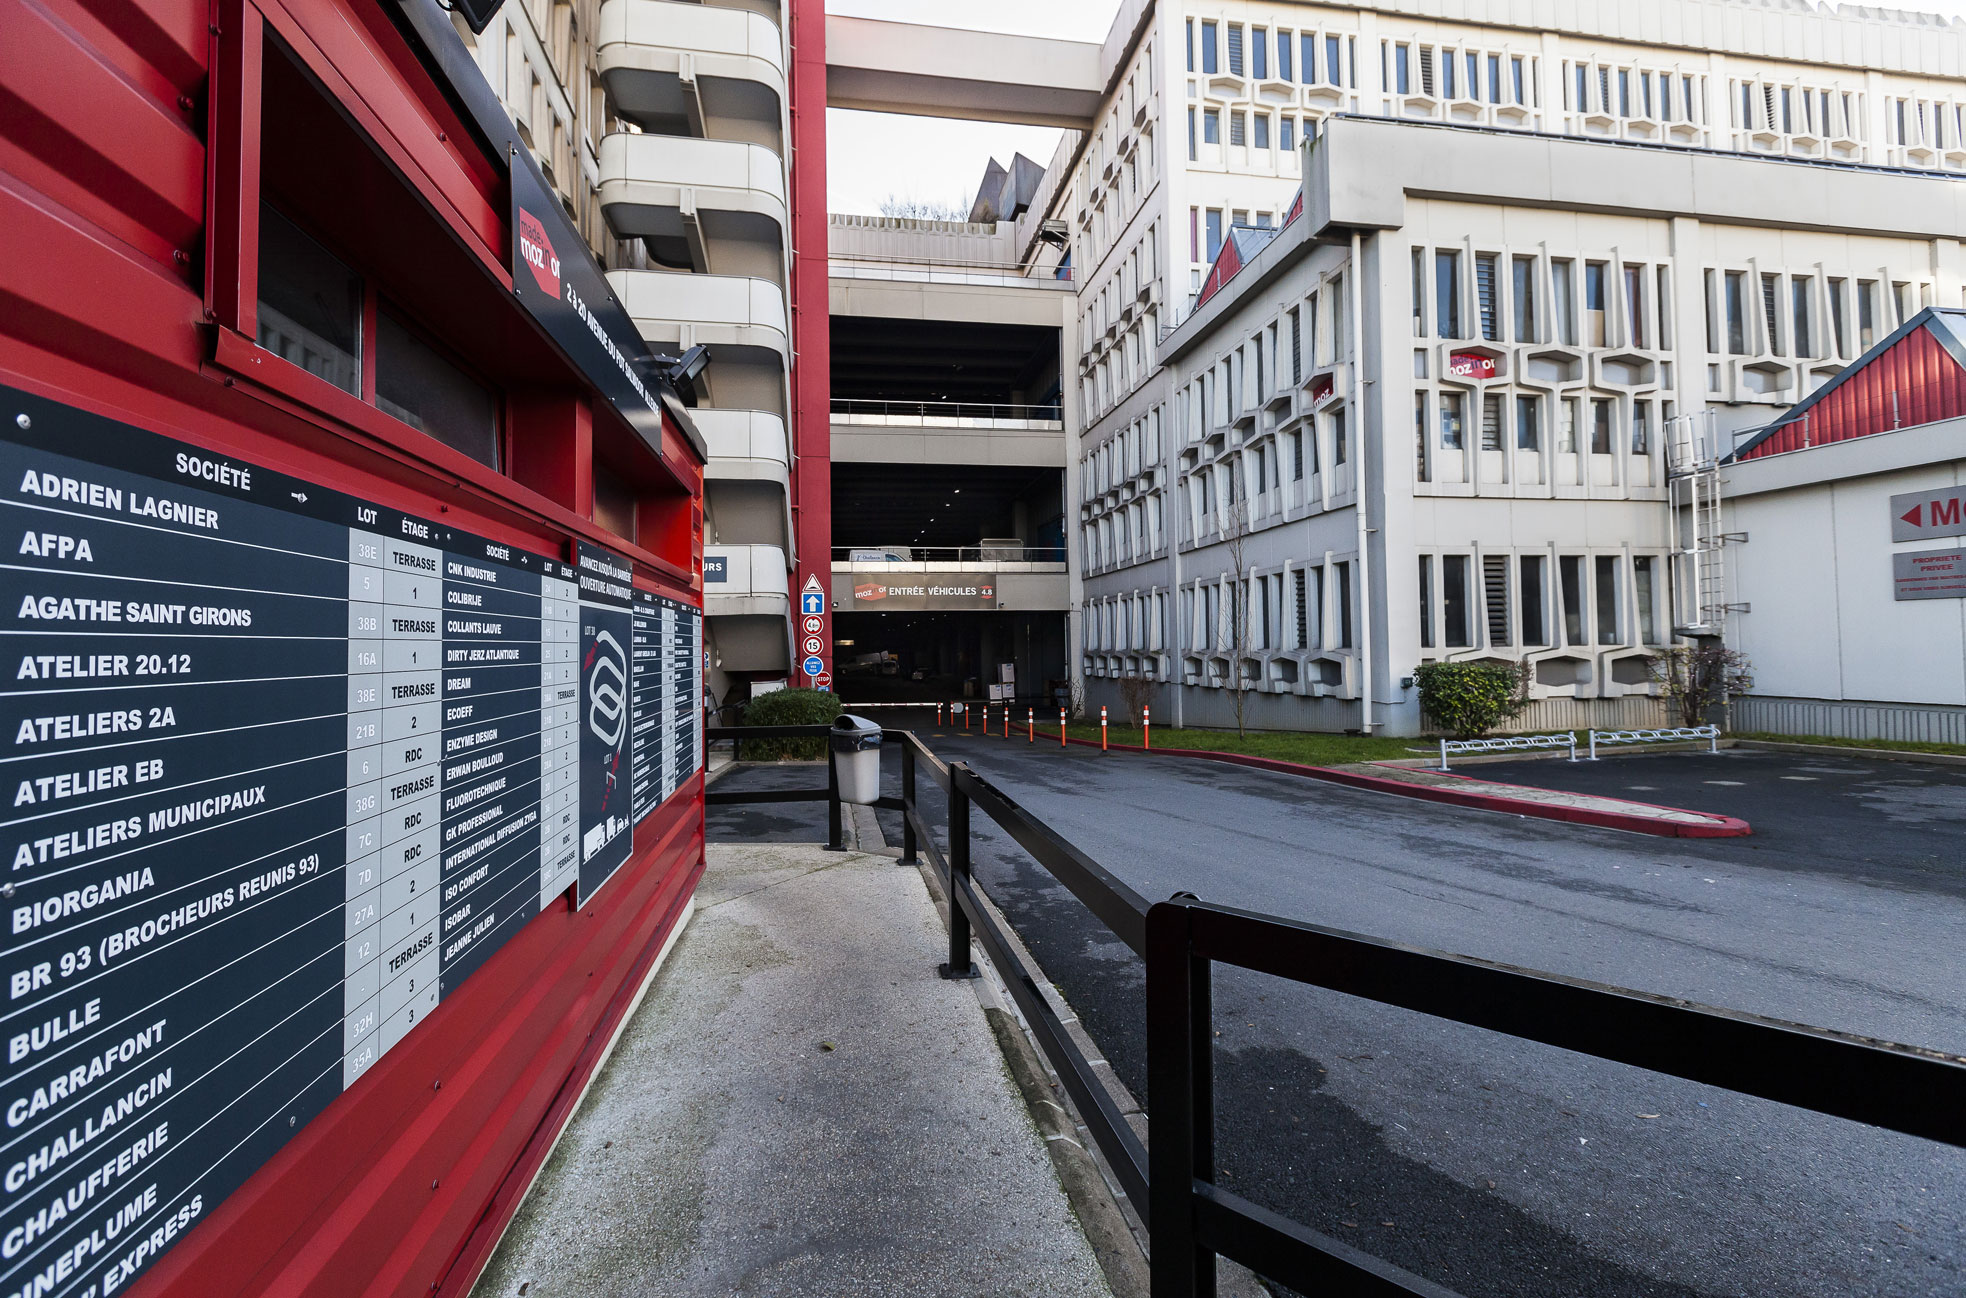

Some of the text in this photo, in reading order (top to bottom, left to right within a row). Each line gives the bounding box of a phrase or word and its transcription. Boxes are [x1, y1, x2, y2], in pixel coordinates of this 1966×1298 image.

[566, 282, 572, 304] 2
[578, 298, 586, 322] 20
[587, 310, 608, 350] AVENUE
[608, 338, 616, 360] DU
[616, 348, 625, 372] PDT
[625, 362, 644, 398] SALVADOR
[176, 452, 250, 490] SOCIÉTÉ
[20, 470, 219, 529] ADRIEN LAGNIER
[358, 506, 377, 525] LOT
[1930, 498, 1966, 526] M
[402, 517, 428, 540] ÉTAGE
[19, 530, 93, 562] AFPA
[358, 544, 377, 560] 38E
[486, 544, 509, 561] SOCIÉTÉ
[393, 552, 436, 571] TERRASSE
[580, 555, 598, 572] AVANCEZ
[613, 566, 617, 578] LA
[1912, 555, 1962, 564] PROPRIETE
[448, 562, 496, 582] CNK INDUSTRIE
[561, 565, 573, 578] ÉTAGE
[364, 577, 370, 590] 5
[580, 575, 606, 594] OUVERTURE
[606, 583, 631, 600] AUTOMATIQUE
[889, 586, 924, 596] ENTRÉE
[928, 586, 976, 596] VÉHICULES
[412, 587, 417, 600] 1
[448, 591, 482, 606] COLIBRIJE
[18, 595, 251, 627] AGATHE SAINT GIRONS
[358, 617, 377, 630] 38B
[392, 619, 435, 633] TERRASSE
[448, 621, 501, 634] COLLANTS LAUVE
[358, 653, 376, 666] 16A
[412, 652, 417, 664] 1
[448, 649, 519, 661] DIRTY JERZ ATLANTIQUE
[17, 654, 191, 680] ATELIER 20.12
[392, 683, 435, 699] TERRASSE
[448, 678, 471, 690] DREAM
[357, 689, 375, 703] 38E
[558, 689, 576, 700] TERRASSE
[447, 705, 473, 720] ECOEFF
[15, 706, 176, 744] ATELIERS 2A
[356, 724, 375, 740] 21B
[412, 716, 416, 729] 2
[447, 728, 498, 752] ENZYME DESIGN
[405, 748, 422, 763] RDC
[362, 761, 368, 774] 6
[446, 762, 471, 781] ERWAN
[14, 759, 164, 807] ATELIER EB
[391, 776, 434, 800] TERRASSE
[446, 777, 506, 812] FLUOROTECHNIQUE
[355, 796, 375, 814] 38G
[12, 786, 265, 870] ATELIERS MUNICIPAUX
[404, 812, 422, 830] RDC
[446, 805, 503, 841] GK PROFESSIONAL
[359, 833, 372, 849] 7C
[446, 833, 496, 871] INTERNATIONAL
[497, 817, 524, 842] DIFFUSION
[404, 844, 422, 863] RDC
[557, 850, 575, 870] TERRASSE
[358, 868, 372, 886] 7D
[410, 880, 416, 893] 2
[446, 864, 489, 902] ISO CONFORT
[12, 867, 154, 934] BIORGANIA
[354, 904, 374, 926] 27A
[410, 912, 414, 925] 1
[445, 904, 471, 932] ISOBAR
[11, 854, 319, 1000] BR 93 (BROCHEURS REUNIS 93)
[444, 913, 495, 961] JEANNE JULIEN
[358, 942, 370, 959] 12
[389, 932, 432, 974] TERRASSE
[409, 979, 414, 993] 3
[409, 1009, 414, 1023] 3
[9, 998, 100, 1064] BULLE
[6, 1019, 166, 1128] CARRAFONT
[4, 1067, 172, 1193] CHALLANCIN
[1, 1121, 168, 1259] CHAUFFERIE
[8, 1183, 157, 1298] INEPLUME
[103, 1194, 202, 1297] EXPRESS
